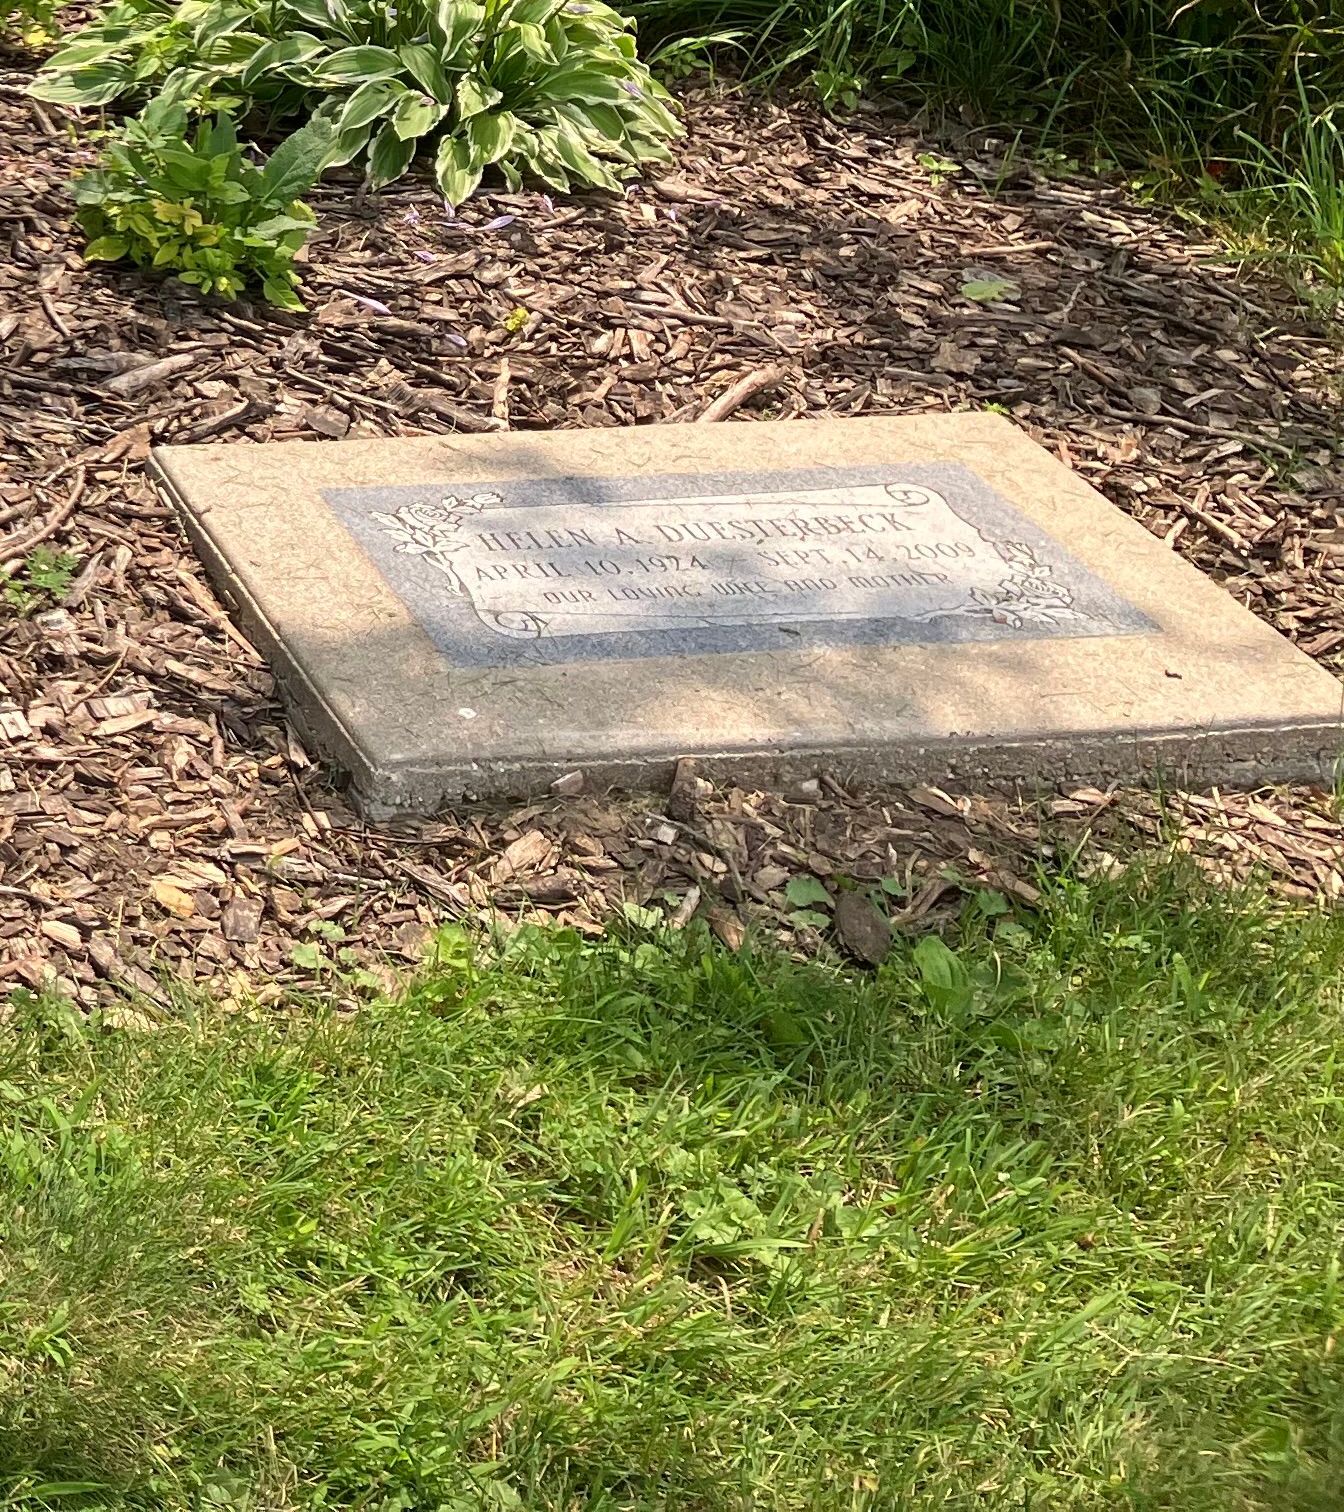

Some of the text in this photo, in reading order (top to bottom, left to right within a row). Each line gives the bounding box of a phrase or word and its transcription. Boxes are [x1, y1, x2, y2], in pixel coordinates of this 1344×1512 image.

[478, 528, 596, 552] HELEN
[653, 513, 914, 543] DUESTERBECK
[475, 561, 572, 581] APRIL
[897, 542, 976, 560] 2009
[543, 589, 597, 604] OUR
